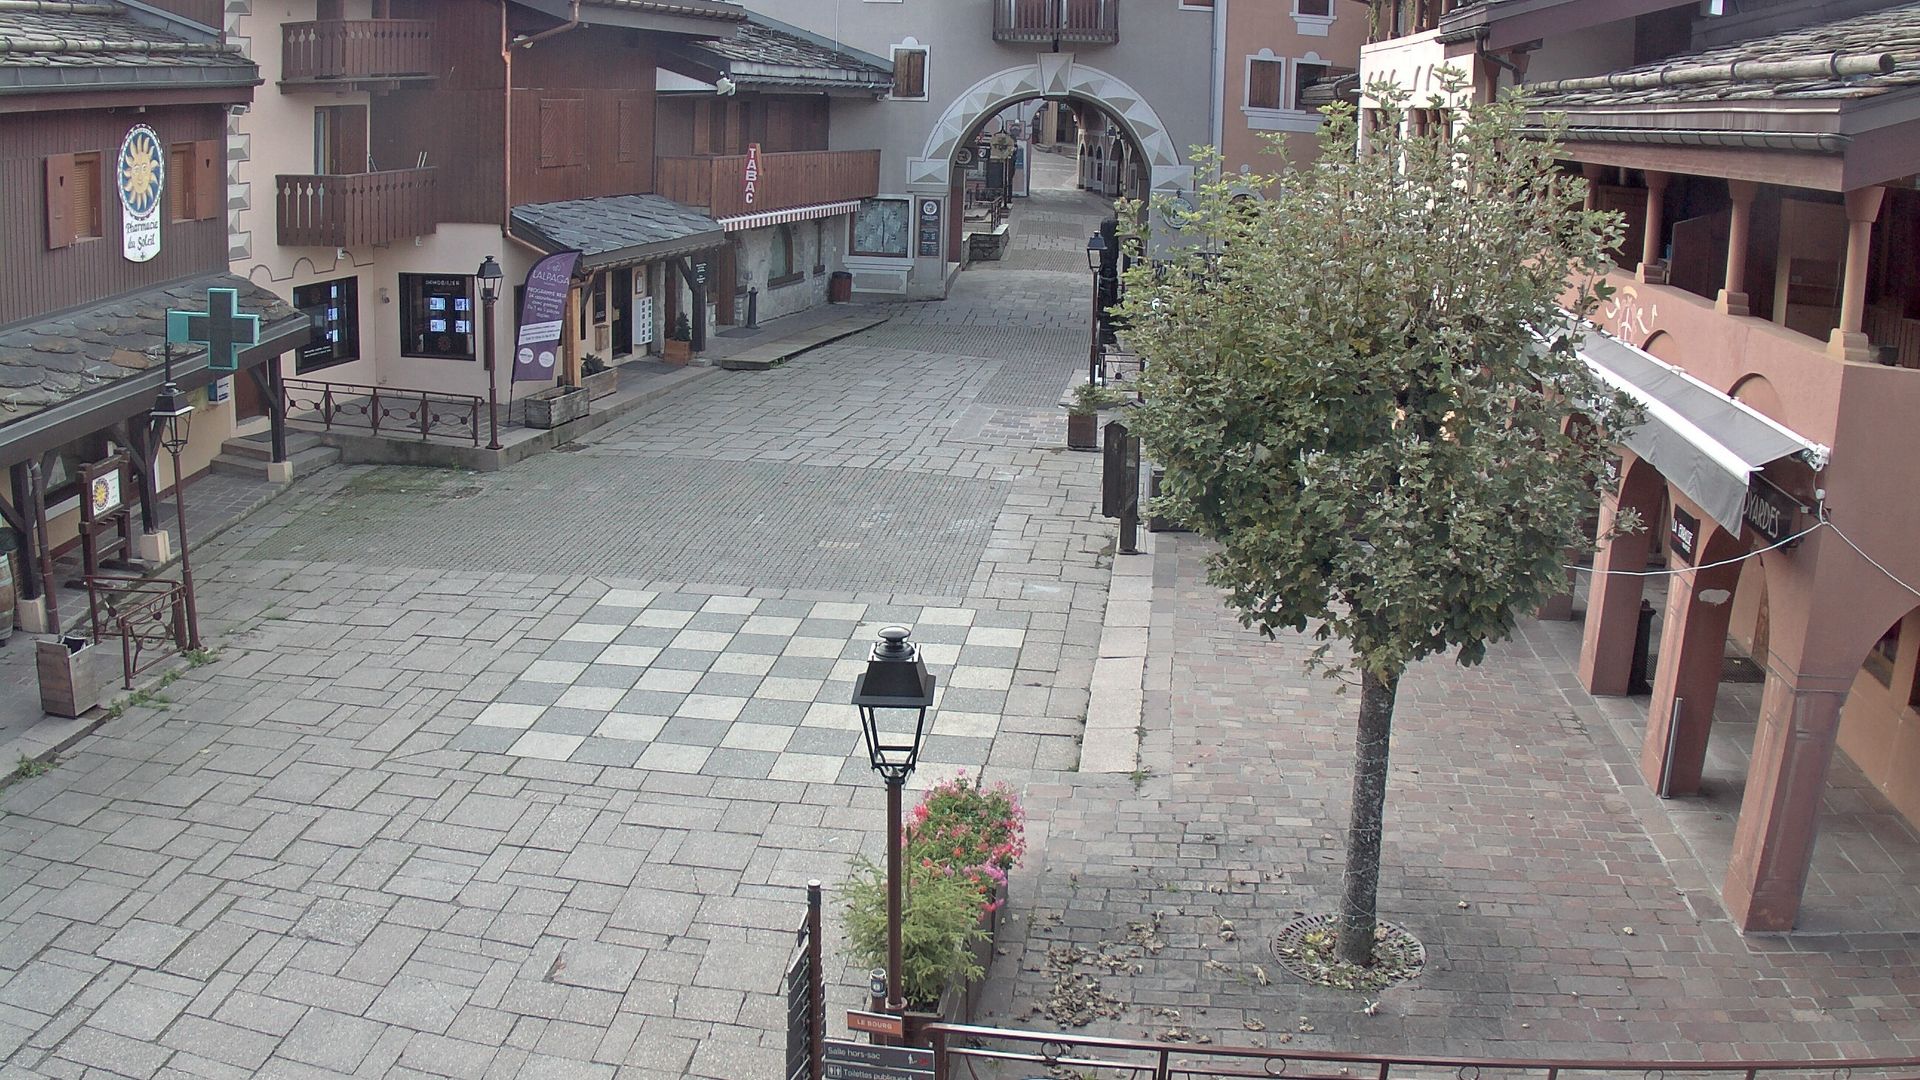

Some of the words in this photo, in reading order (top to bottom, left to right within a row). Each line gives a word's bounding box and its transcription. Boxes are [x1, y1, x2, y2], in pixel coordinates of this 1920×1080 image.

[745, 148, 757, 204] TABAC
[126, 221, 158, 233] Pharmacie
[137, 233, 155, 251] Soleil
[867, 1020, 893, 1030] BOURG
[827, 1046, 846, 1056] Salle
[847, 1048, 881, 1060] hors-sac
[843, 1069, 873, 1080] Toilettes
